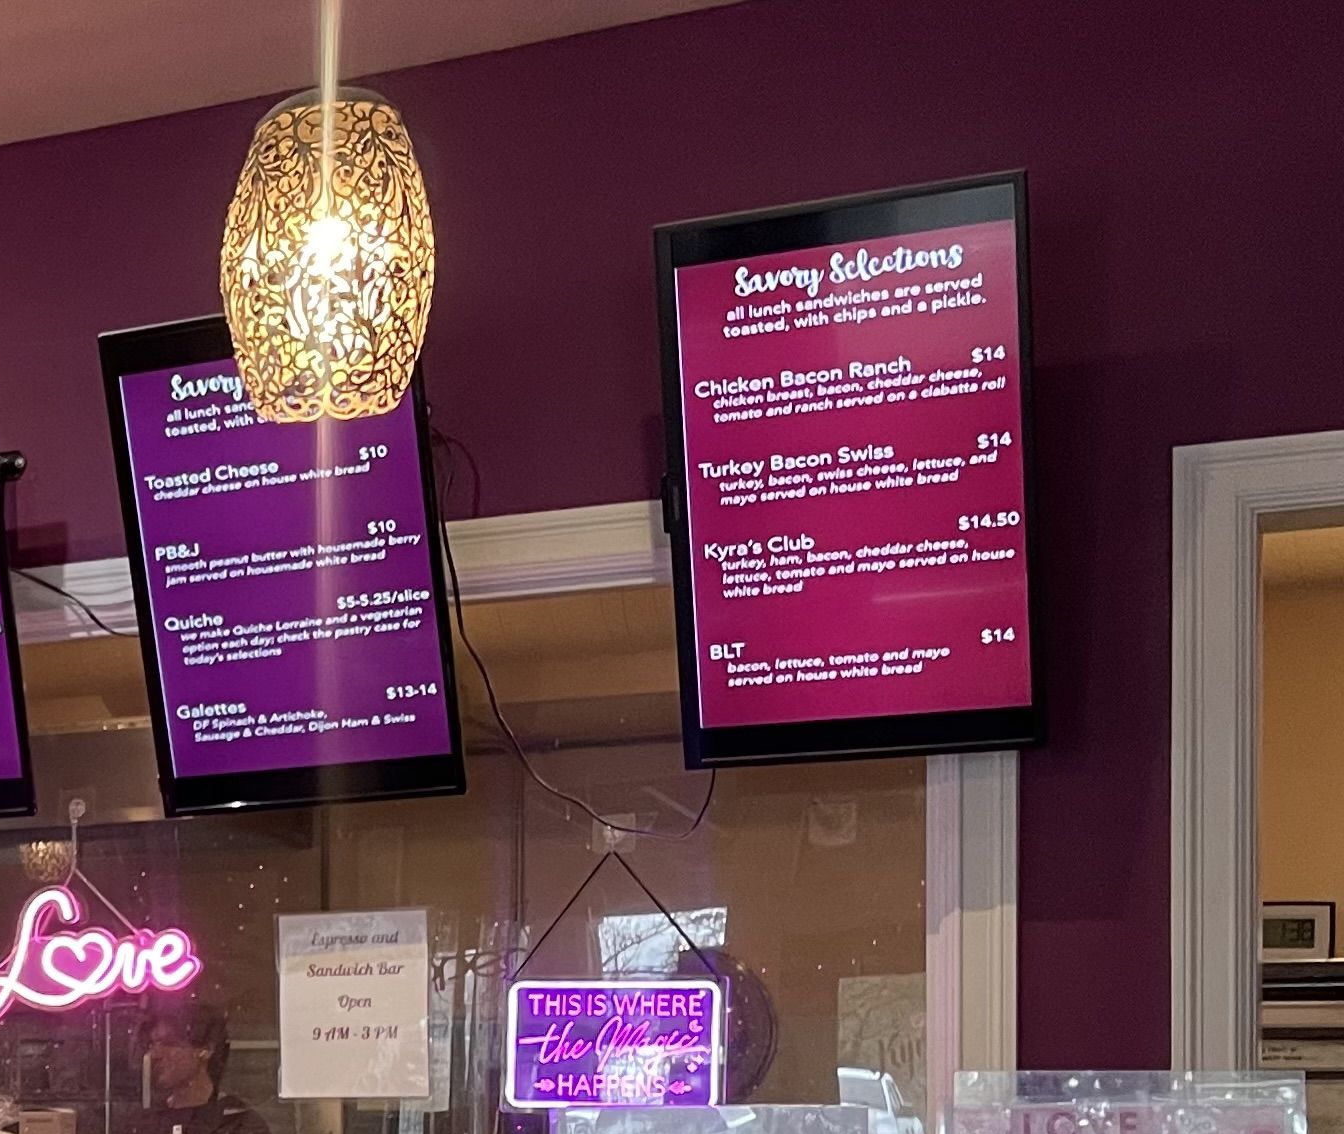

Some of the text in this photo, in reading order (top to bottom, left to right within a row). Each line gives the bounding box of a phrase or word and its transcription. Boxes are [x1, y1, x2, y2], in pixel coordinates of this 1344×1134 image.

[734, 244, 963, 297] Savory Selections
[726, 272, 983, 322] all lunch sandwiches are served
[722, 292, 987, 338] toasted, with chips and a pickle.
[971, 345, 1006, 363] $14
[694, 355, 912, 398] Chicken Bacon Ranch
[170, 374, 243, 401] Savory
[713, 367, 983, 409] chicken breast, bacon, cheddar cheese,
[166, 403, 221, 423] all lunch
[164, 413, 254, 438] toasted, with
[977, 431, 1013, 450] $14
[358, 444, 388, 460] $10
[697, 444, 895, 479] Turkey Bacon Swiss
[143, 462, 279, 490] Toasted Cheese
[367, 519, 397, 535] $10
[958, 511, 1020, 531] $14.50
[154, 542, 200, 561] PB&J
[704, 533, 815, 561] Kyra's Club
[164, 613, 224, 631] Quiche
[981, 627, 1015, 644] $14
[709, 642, 746, 660] BLT
[728, 660, 923, 687] served on house white bread
[386, 682, 438, 700] $13-14
[176, 702, 247, 720] Galettes
[311, 930, 399, 950] Espresso and
[306, 960, 406, 978] Sandwich Bar
[337, 994, 372, 1013] Open
[528, 991, 704, 1017] THIS IS WHERE
[312, 1024, 399, 1042] 9 AM 3 PM
[518, 1015, 712, 1077] the Magic
[557, 1073, 666, 1097] HAPPENS
